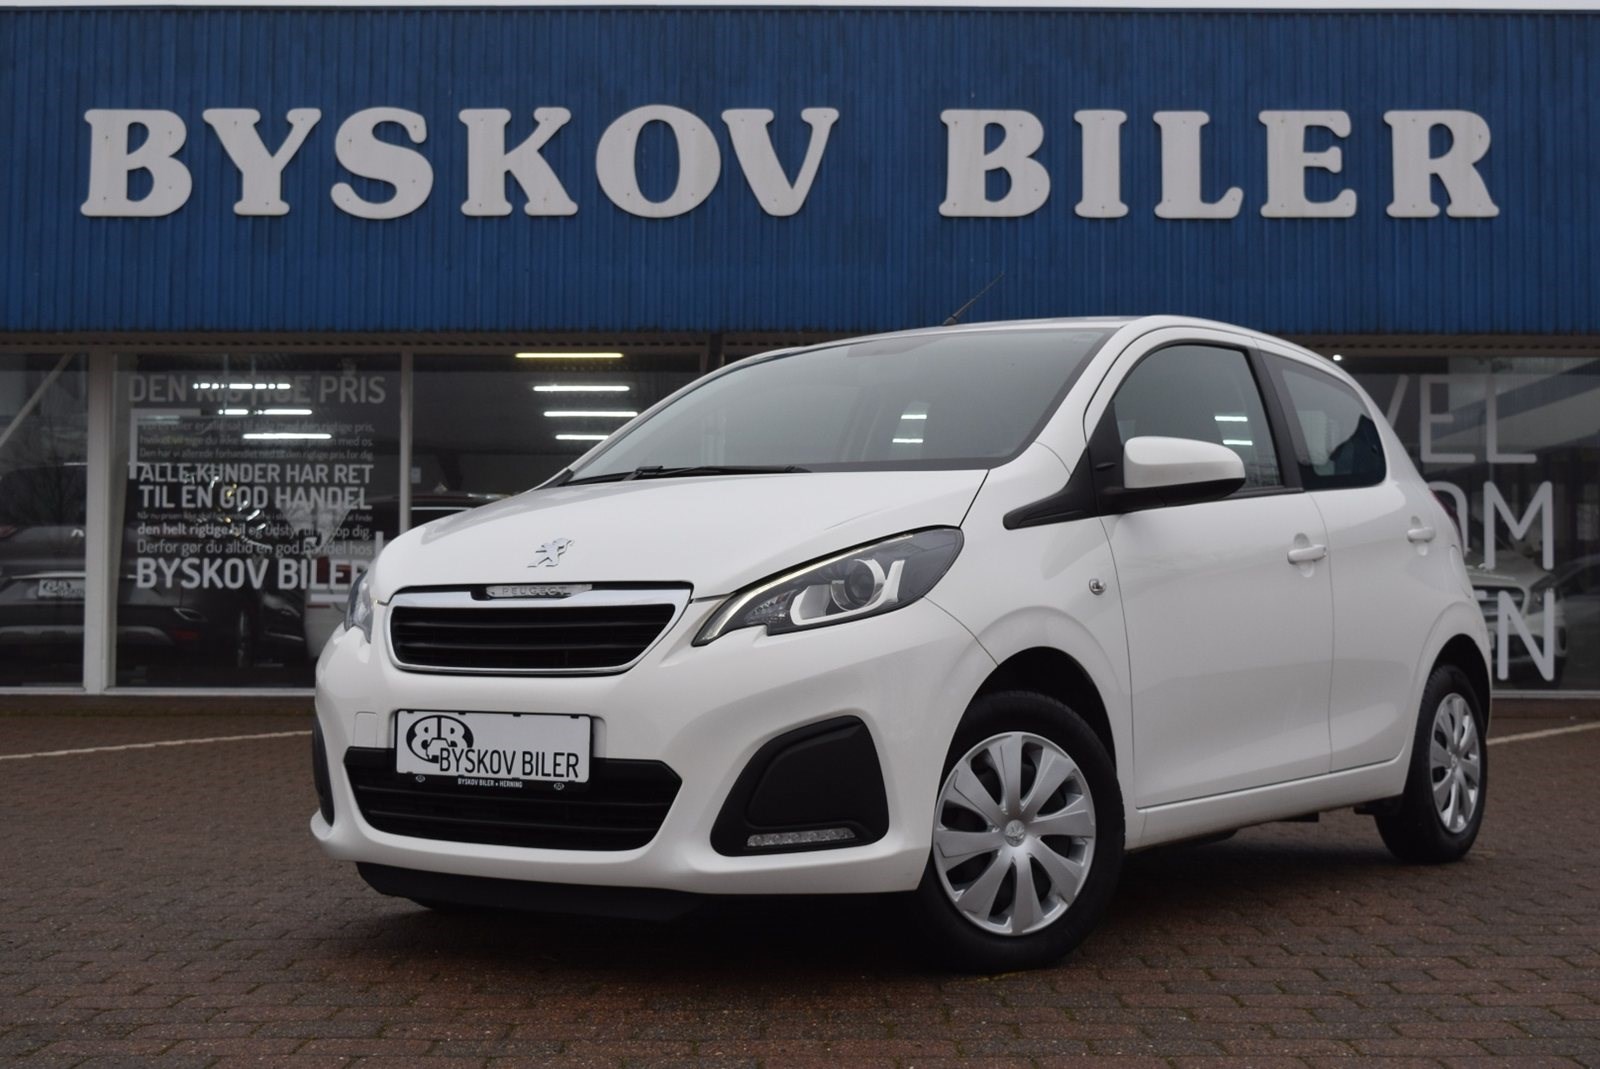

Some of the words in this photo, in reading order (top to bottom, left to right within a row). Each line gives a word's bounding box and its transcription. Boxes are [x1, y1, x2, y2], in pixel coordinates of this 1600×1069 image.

[81, 104, 839, 219] BYSKOV
[939, 108, 1500, 218] BILER
[128, 375, 187, 402] DEN
[319, 375, 386, 404] PRIS
[140, 463, 192, 483] ALLE
[195, 463, 281, 483] KUNDER
[286, 463, 329, 483] HAR
[334, 464, 374, 484] RET
[138, 485, 176, 508] TIL
[181, 485, 213, 508] EN
[220, 485, 268, 509] GOD
[275, 486, 373, 511] HANDEL
[137, 522, 160, 535] den
[163, 522, 187, 535] helt
[189, 522, 228, 538] rigtige
[231, 522, 246, 535] bil
[352, 525, 373, 541] dig.
[137, 539, 177, 553] Derfor
[181, 543, 202, 557] gør
[206, 539, 222, 553] du
[225, 540, 253, 554] altid
[276, 540, 300, 558] god
[136, 557, 270, 590] BYSKOV
[501, 585, 567, 595] PEUGEOT
[440, 747, 517, 775] BYSKOV
[521, 751, 580, 778] BILER
[457, 778, 478, 787] BYSKOV
[479, 779, 495, 787] BILER
[499, 780, 524, 789] HERNING
